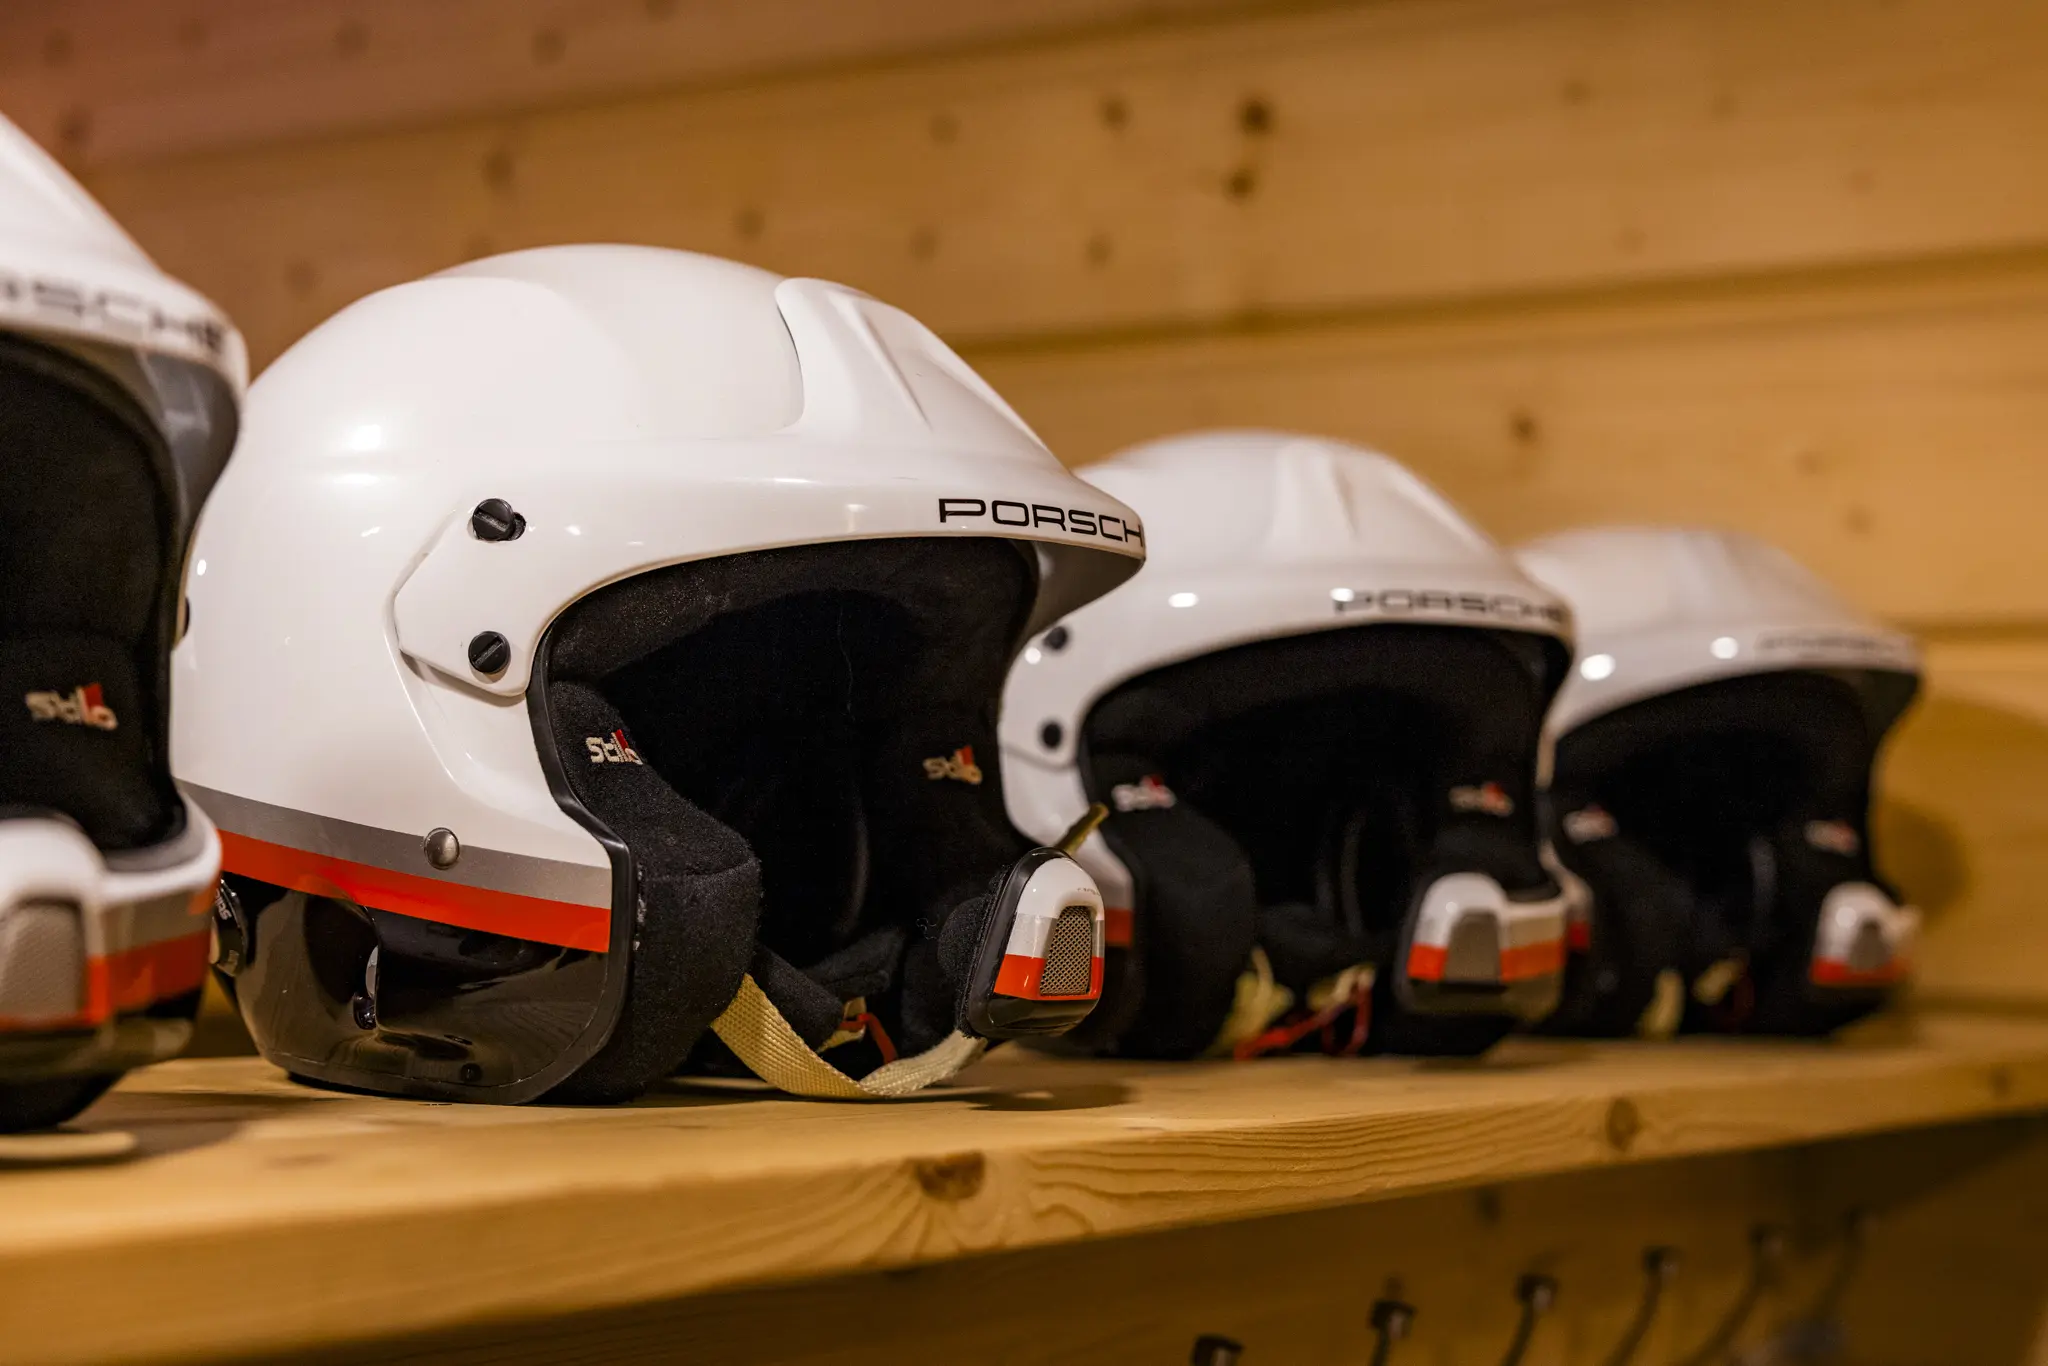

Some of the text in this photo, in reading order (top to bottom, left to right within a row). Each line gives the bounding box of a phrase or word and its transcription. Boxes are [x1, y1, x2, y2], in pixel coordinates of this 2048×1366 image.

[938, 498, 1144, 547] PORSCH
[25, 682, 118, 731] Stilo
[923, 745, 983, 785] Stilo
